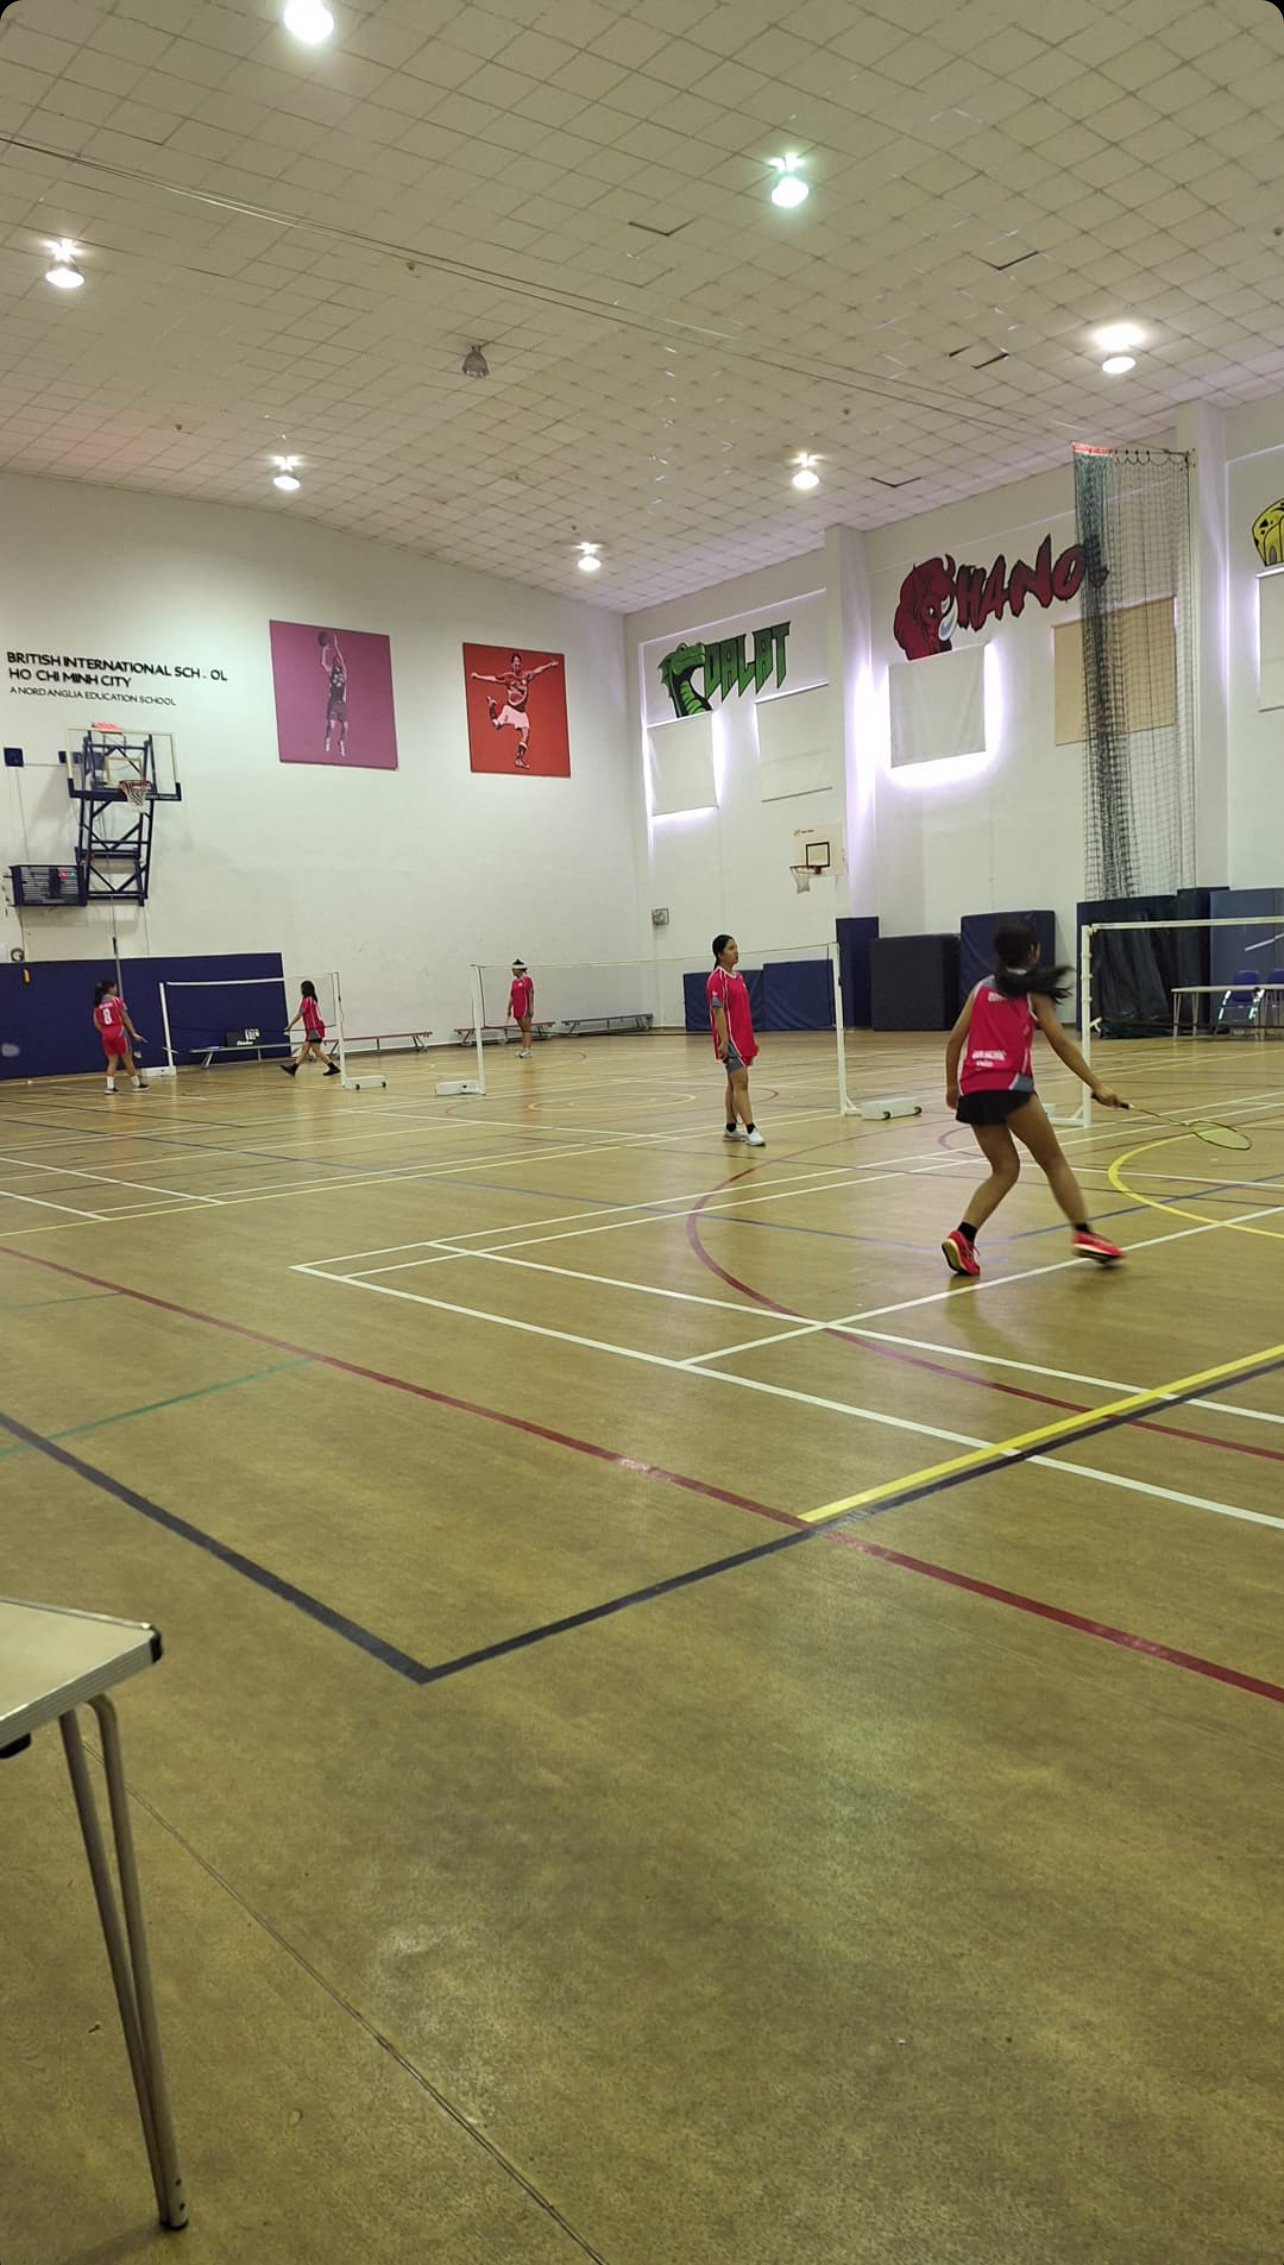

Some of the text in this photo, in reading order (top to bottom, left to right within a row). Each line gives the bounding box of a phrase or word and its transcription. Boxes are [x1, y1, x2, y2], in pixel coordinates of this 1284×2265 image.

[7, 651, 228, 681] BRITISH INTERNATIONAL SCHOL
[704, 621, 791, 702] DALAT
[9, 668, 131, 687] HO CHI MINH CITY
[10, 686, 176, 706] A NORD ANGLIA EDUCATION SCHOOL
